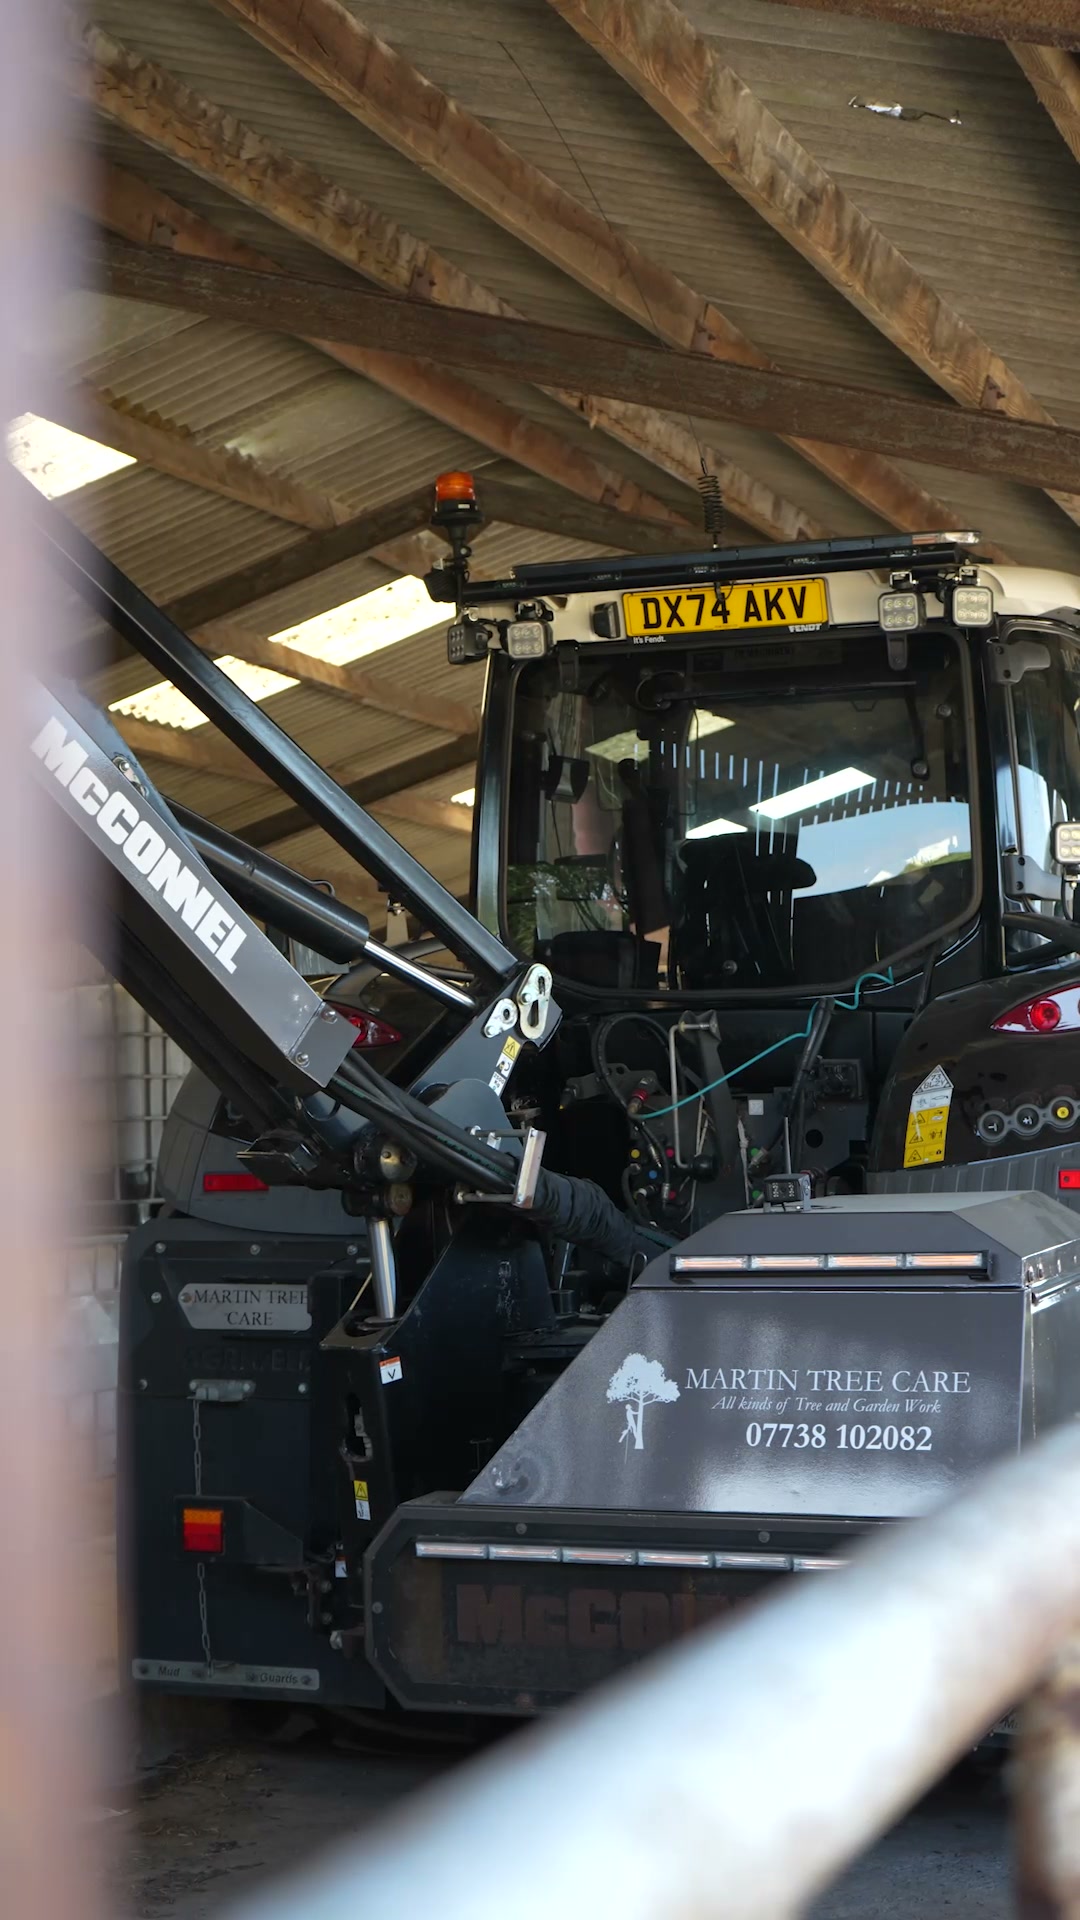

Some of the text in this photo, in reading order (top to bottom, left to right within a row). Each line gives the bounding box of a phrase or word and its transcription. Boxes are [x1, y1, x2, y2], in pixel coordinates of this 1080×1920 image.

[640, 586, 807, 630] DX74 AKV
[788, 623, 822, 633] FENDT
[633, 636, 643, 644] It's
[193, 1289, 308, 1305] MARTIN TREE
[227, 1312, 273, 1326] CARE
[685, 1368, 971, 1394] MARTIN TREE CARE
[712, 1396, 942, 1415] All kinds of Tree and Garden Work
[745, 1422, 933, 1451] 07738 102082
[158, 1666, 299, 1684] Mud Guards
